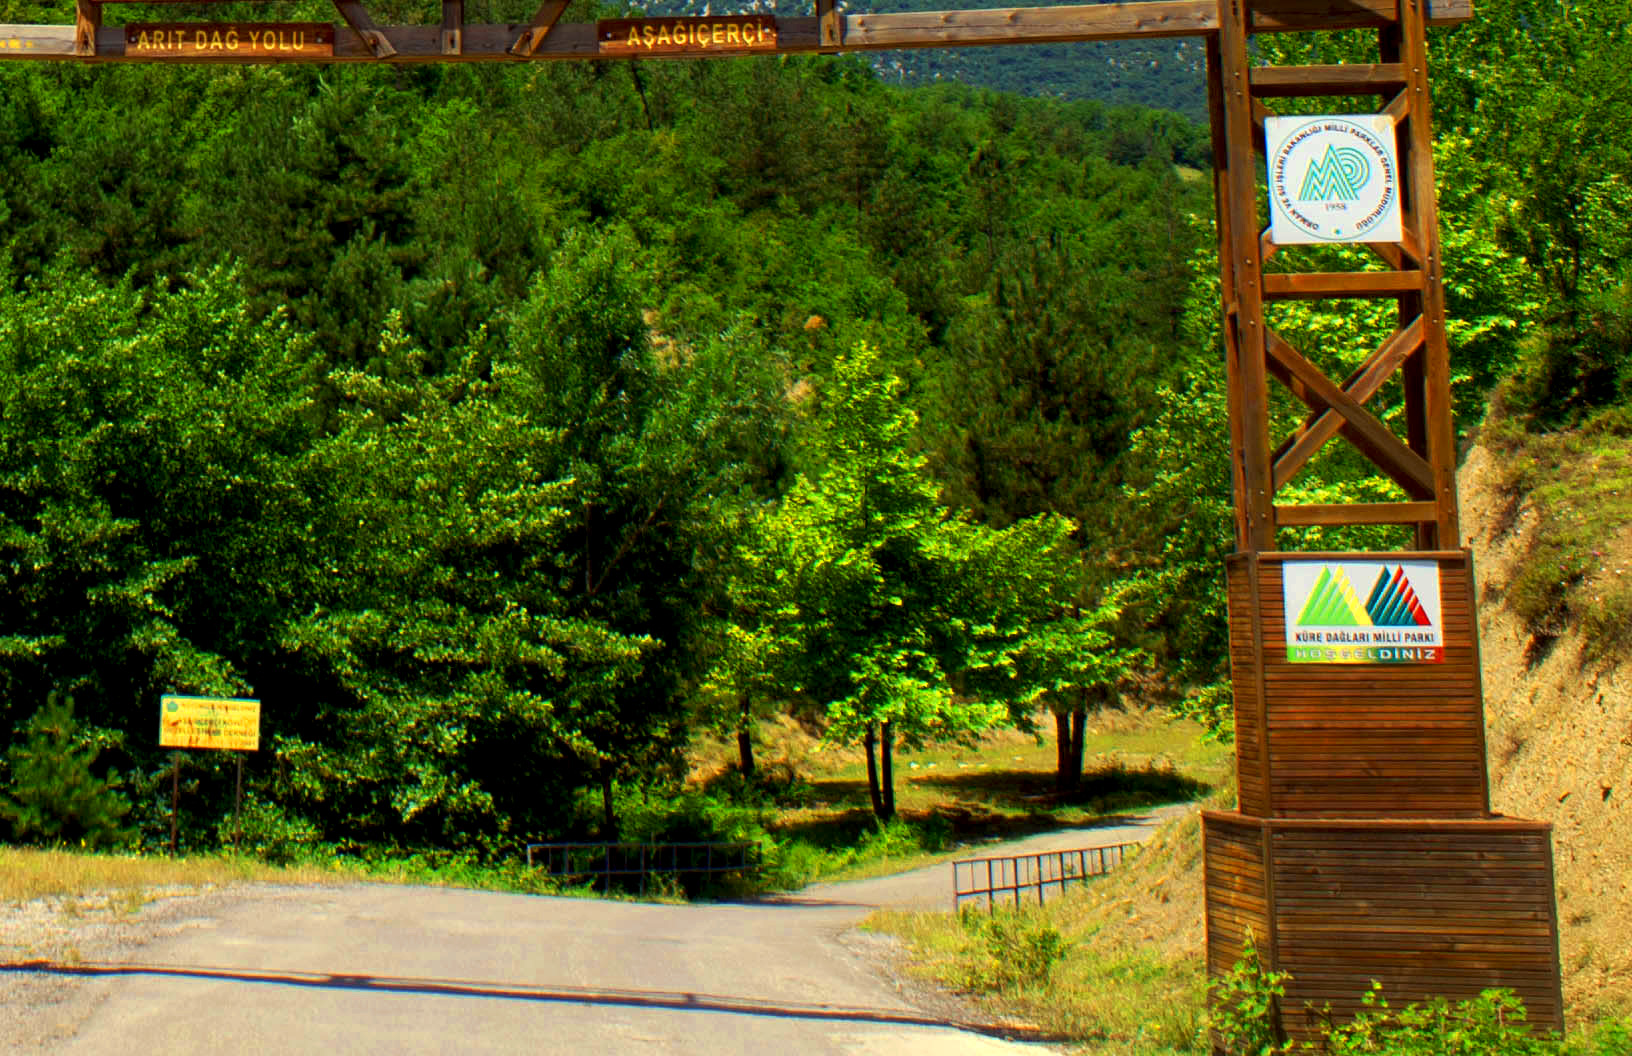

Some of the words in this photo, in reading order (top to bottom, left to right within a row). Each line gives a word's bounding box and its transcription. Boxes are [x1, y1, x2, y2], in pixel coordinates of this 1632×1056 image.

[137, 29, 186, 50] ARIT
[196, 26, 239, 50] DAĞ
[249, 29, 305, 50] YOLU
[627, 19, 764, 50] AŞAĞIÇERÇİ
[1290, 209, 1319, 231] ORMAN
[1295, 630, 1322, 643] KÜRE
[1326, 630, 1369, 643] DAĞLARI
[1373, 630, 1401, 643] MİLLİ
[1404, 631, 1435, 642] PARKI
